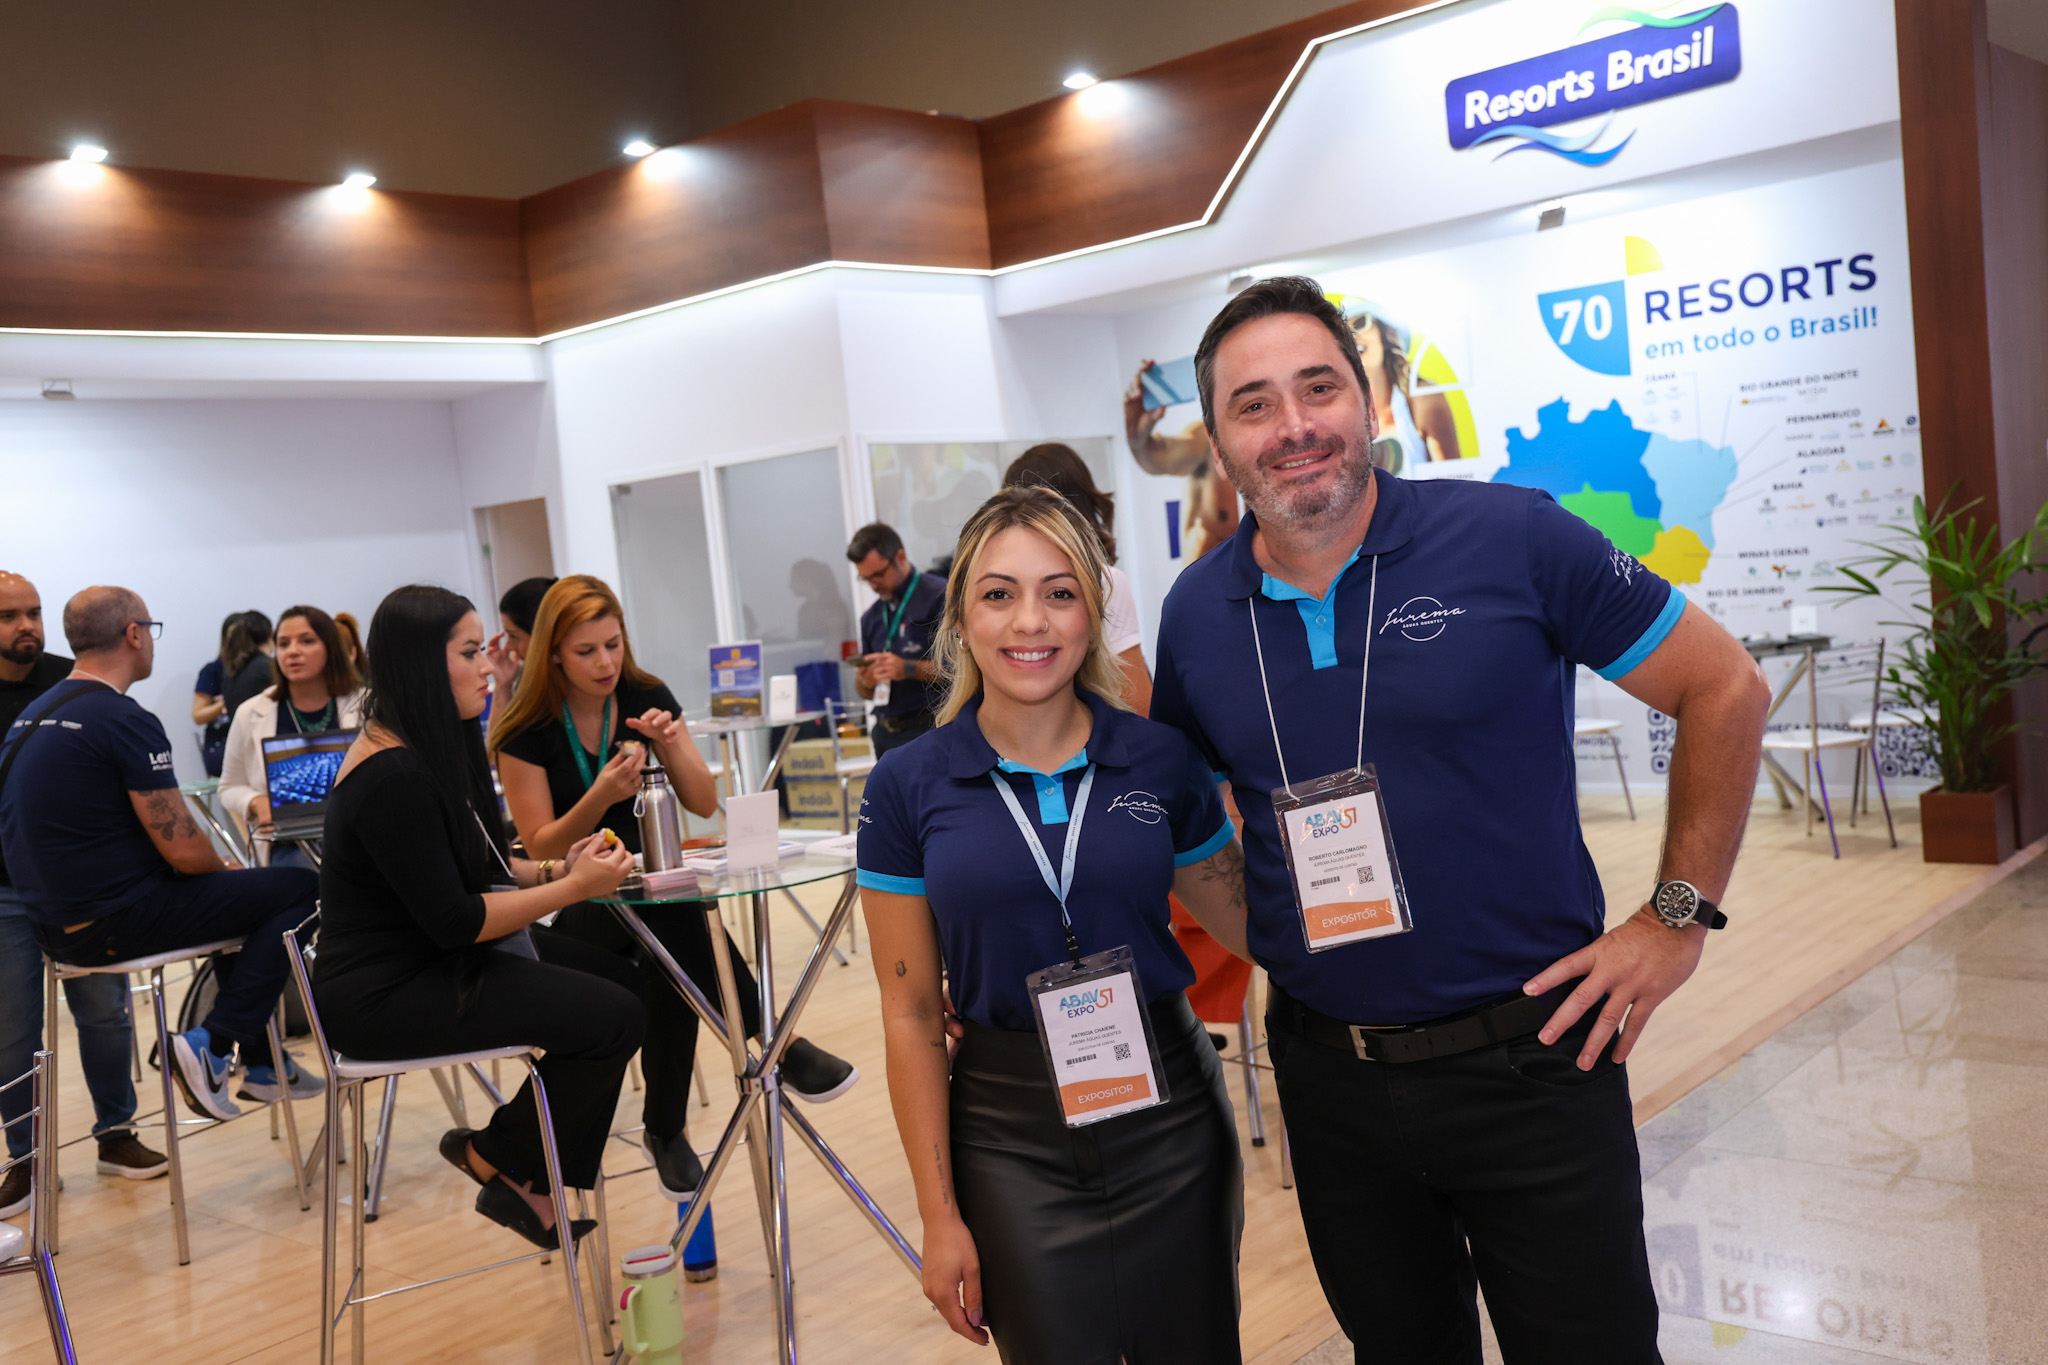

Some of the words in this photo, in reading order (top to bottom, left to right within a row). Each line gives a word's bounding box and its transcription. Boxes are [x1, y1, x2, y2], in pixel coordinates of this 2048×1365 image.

[1464, 70, 1595, 129] Resorts
[1606, 25, 1714, 91] Brasil
[1645, 253, 1877, 324] RESORTS
[1553, 294, 1613, 346] 70
[1646, 339, 1684, 359] em
[1693, 327, 1755, 352] todo
[1764, 326, 1780, 342] o
[1790, 306, 1878, 339] Brasil!
[1760, 376, 1801, 391] GRANDE
[1804, 374, 1821, 384] DO
[1823, 369, 1859, 381] NORTE
[1786, 408, 1861, 424] PERNAMBUCO
[1797, 446, 1846, 458] ALAGOAS
[1772, 481, 1804, 491] BAHIA
[1313, 824, 1339, 838] EXPO
[1308, 853, 1332, 861] ROBERTO
[1332, 844, 1367, 857] CARLOMAGNO
[1321, 909, 1378, 928] EXPOSITOR
[1059, 988, 1098, 1012] ABAV
[1095, 987, 1113, 1008] 51
[1067, 1004, 1095, 1018] EXPO
[1071, 1030, 1094, 1039] PATRICIA
[1077, 1083, 1135, 1104] EXPOSITOR
